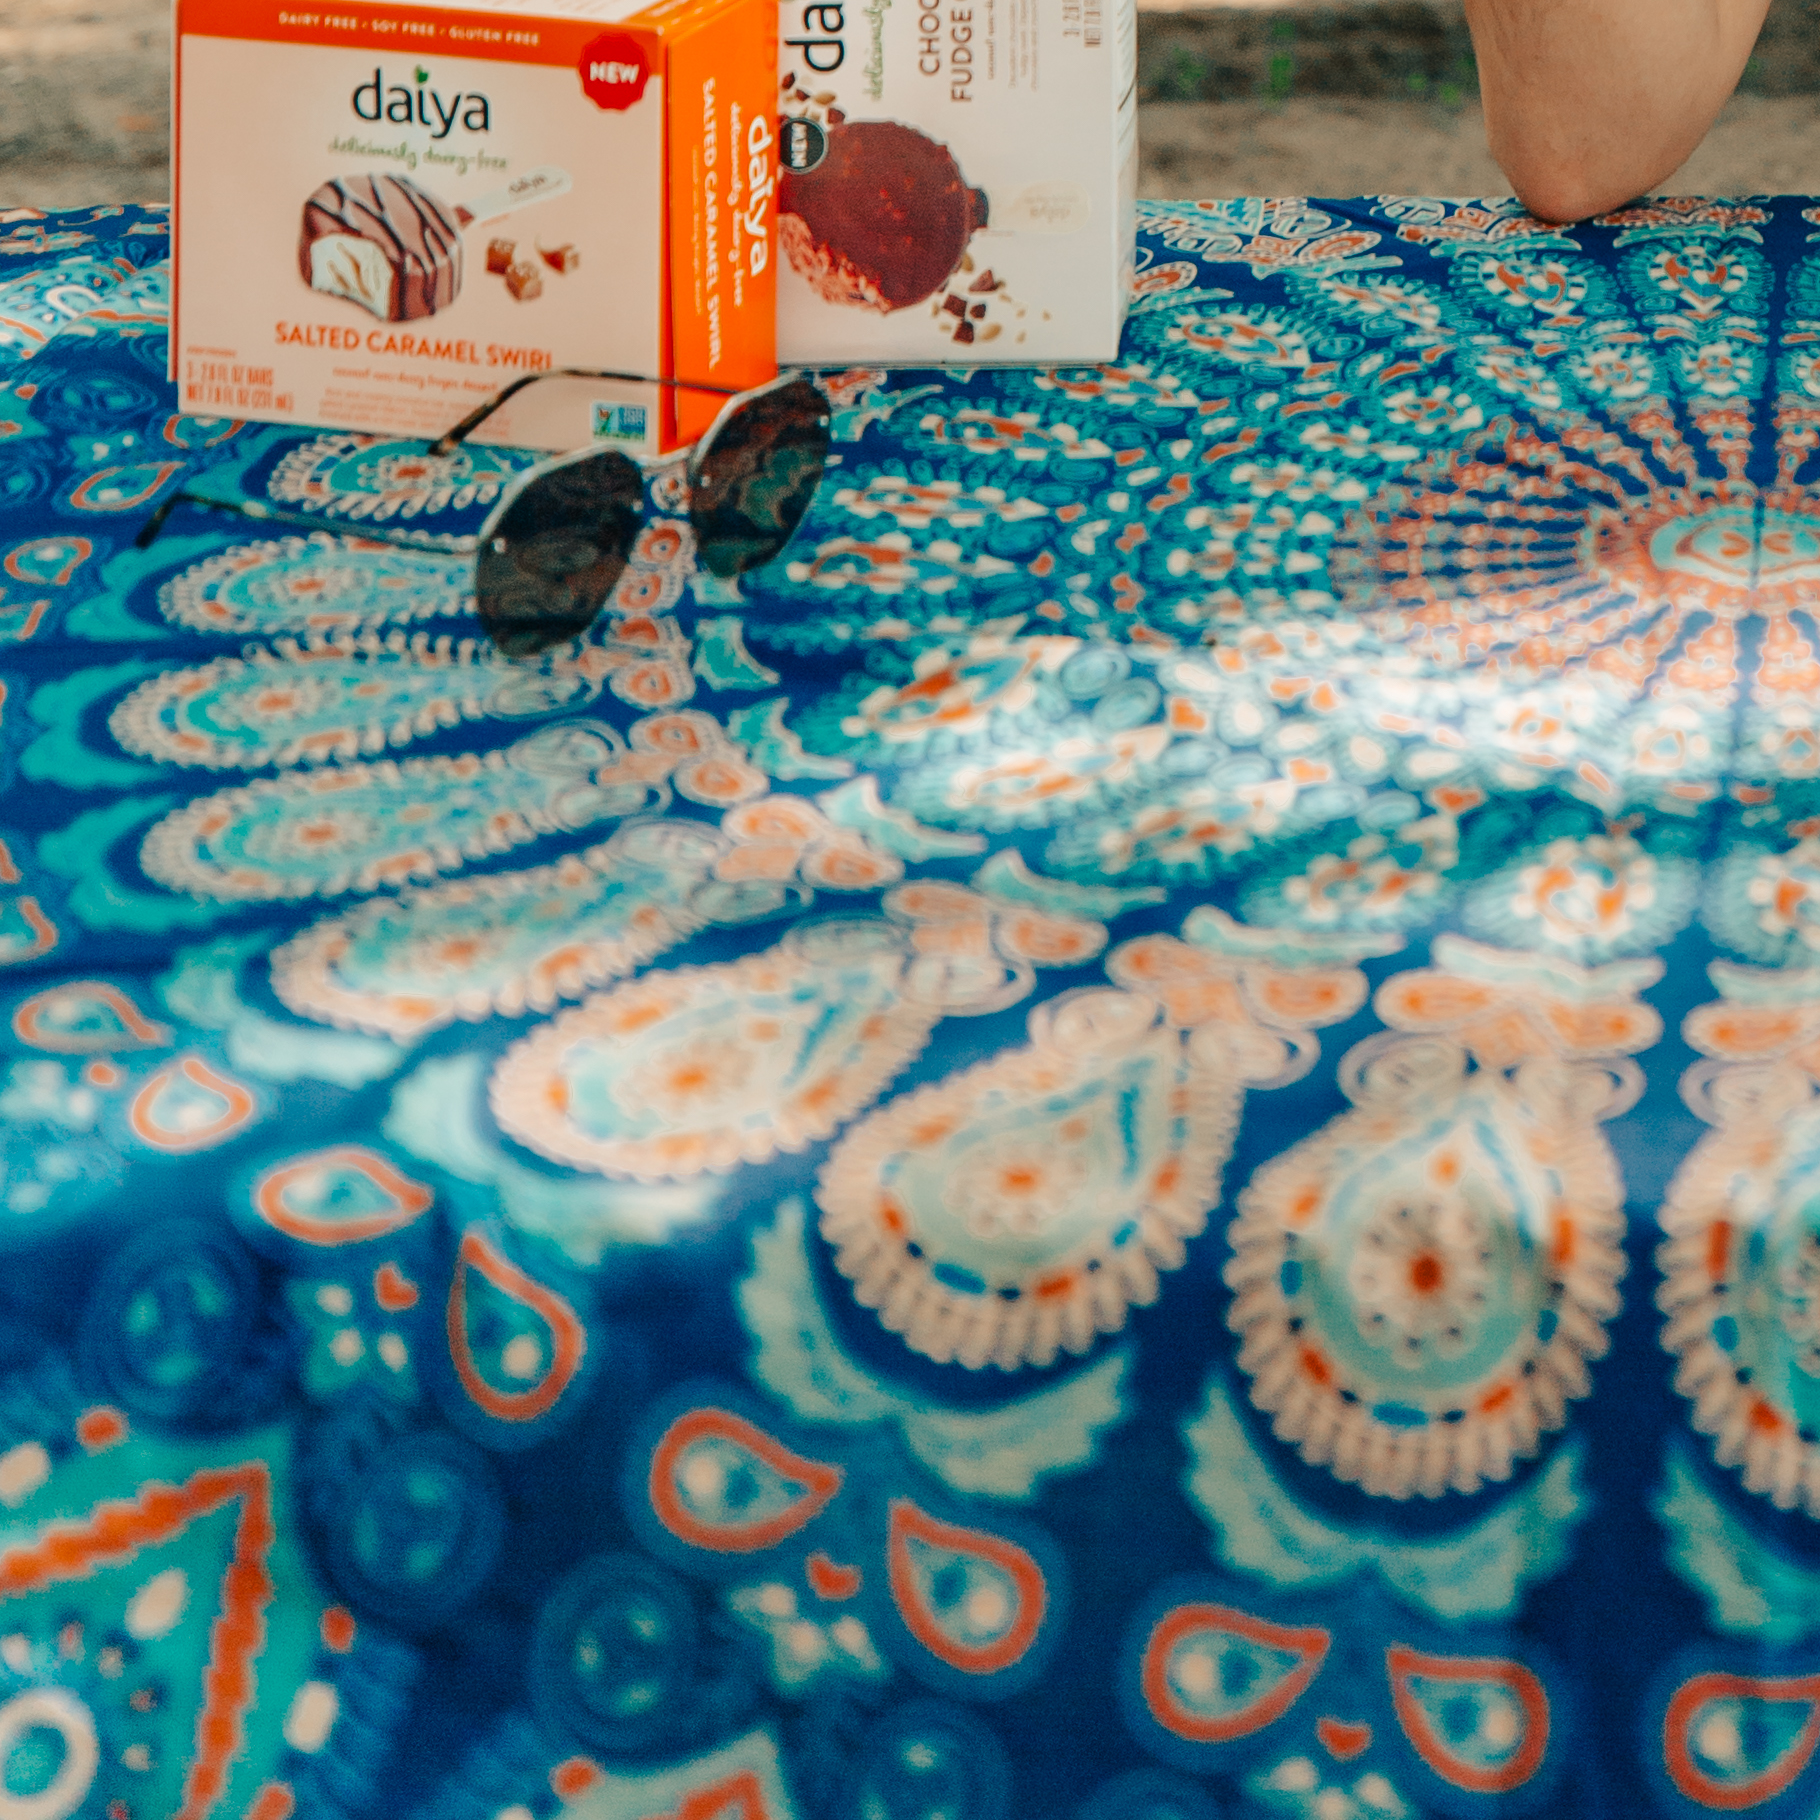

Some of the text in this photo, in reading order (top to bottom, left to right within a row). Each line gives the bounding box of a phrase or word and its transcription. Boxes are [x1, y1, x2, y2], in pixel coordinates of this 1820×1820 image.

[279, 11, 540, 46] DAIRY FREE SOY FREE GLUTEN FREE
[950, 8, 973, 102] FUDGE
[352, 65, 489, 139] daiya
[589, 61, 640, 84] NEW
[791, 122, 808, 167] NEW
[702, 76, 722, 373] SALTED CARAMEL SWIRL
[744, 115, 773, 277] daiya
[275, 320, 361, 350] SALTED
[366, 329, 481, 365] CARAMEL
